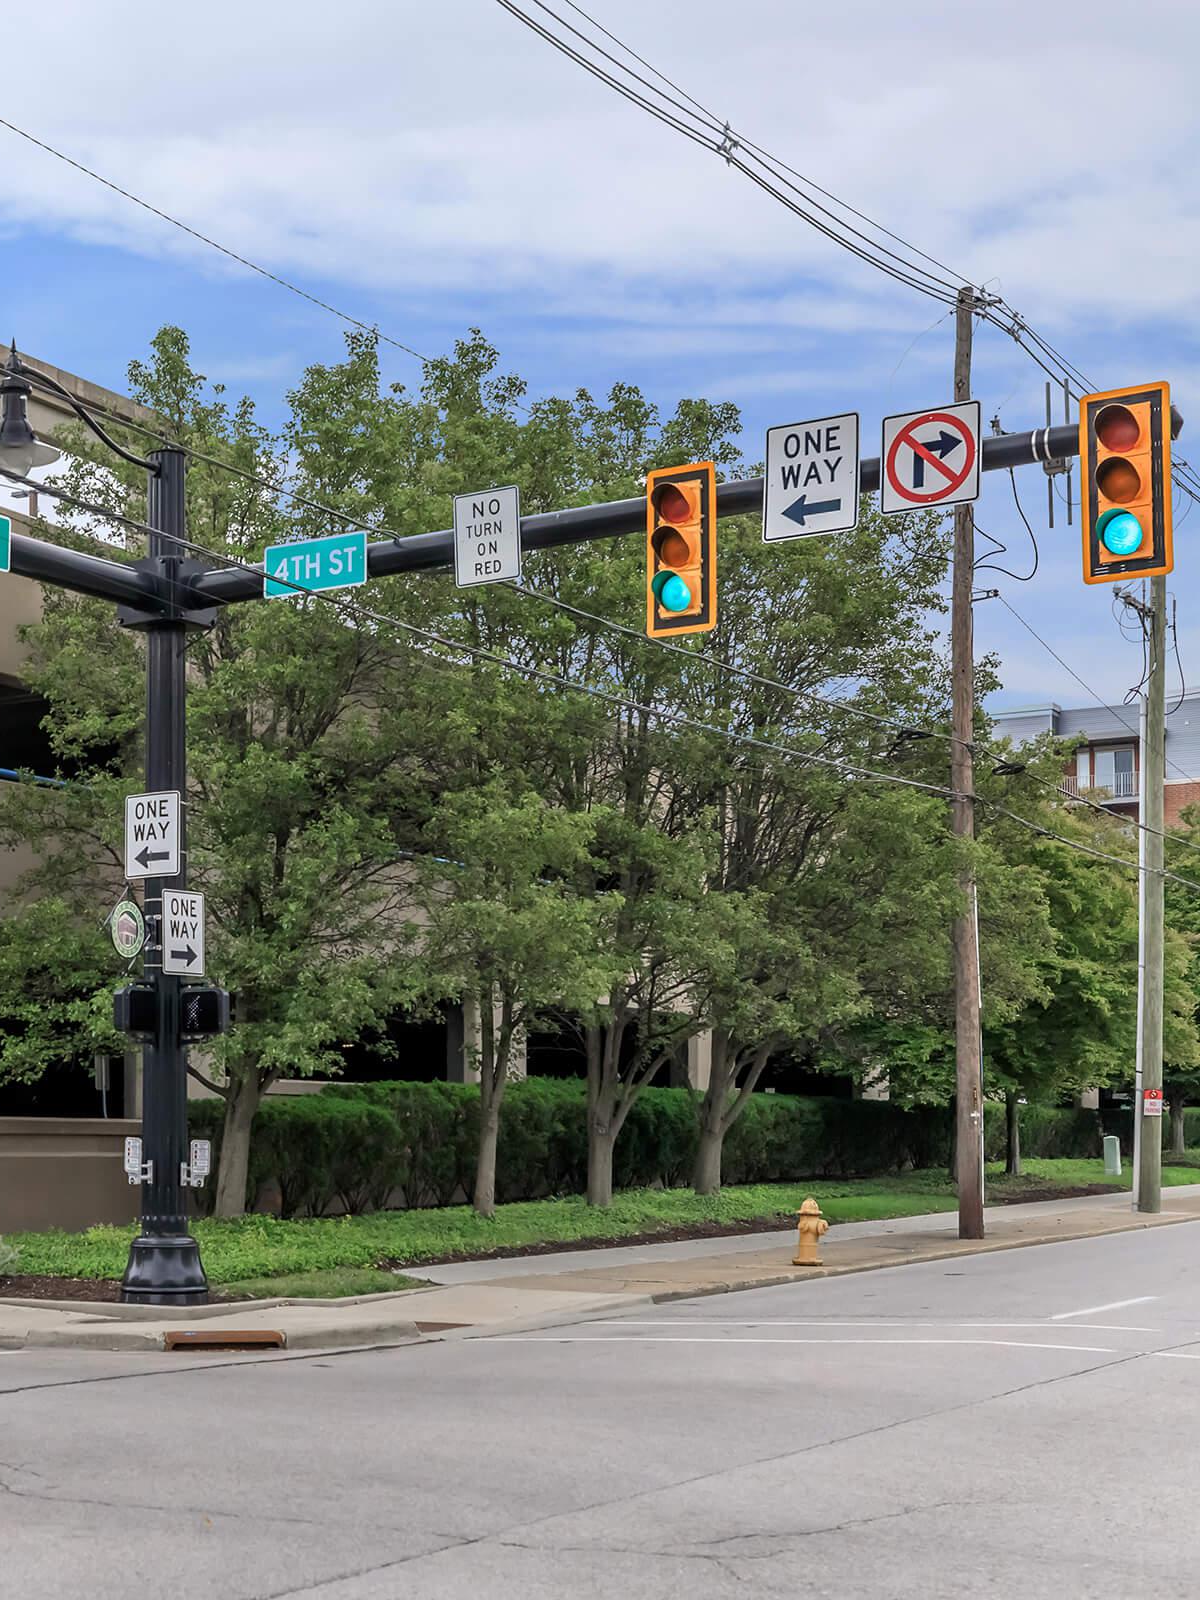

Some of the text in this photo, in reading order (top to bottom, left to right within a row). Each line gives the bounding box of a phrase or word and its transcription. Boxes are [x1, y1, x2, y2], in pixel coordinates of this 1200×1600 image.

[784, 425, 841, 458] ONE
[781, 456, 843, 490] WAY
[472, 498, 500, 519] NO
[465, 520, 502, 539] TURN
[477, 540, 498, 556] ON
[273, 546, 357, 581] 4TH ST
[475, 559, 502, 577] RED
[135, 800, 169, 820] ONE
[134, 821, 170, 842] WAY
[171, 898, 197, 918] ONE
[169, 919, 199, 940] WAY
